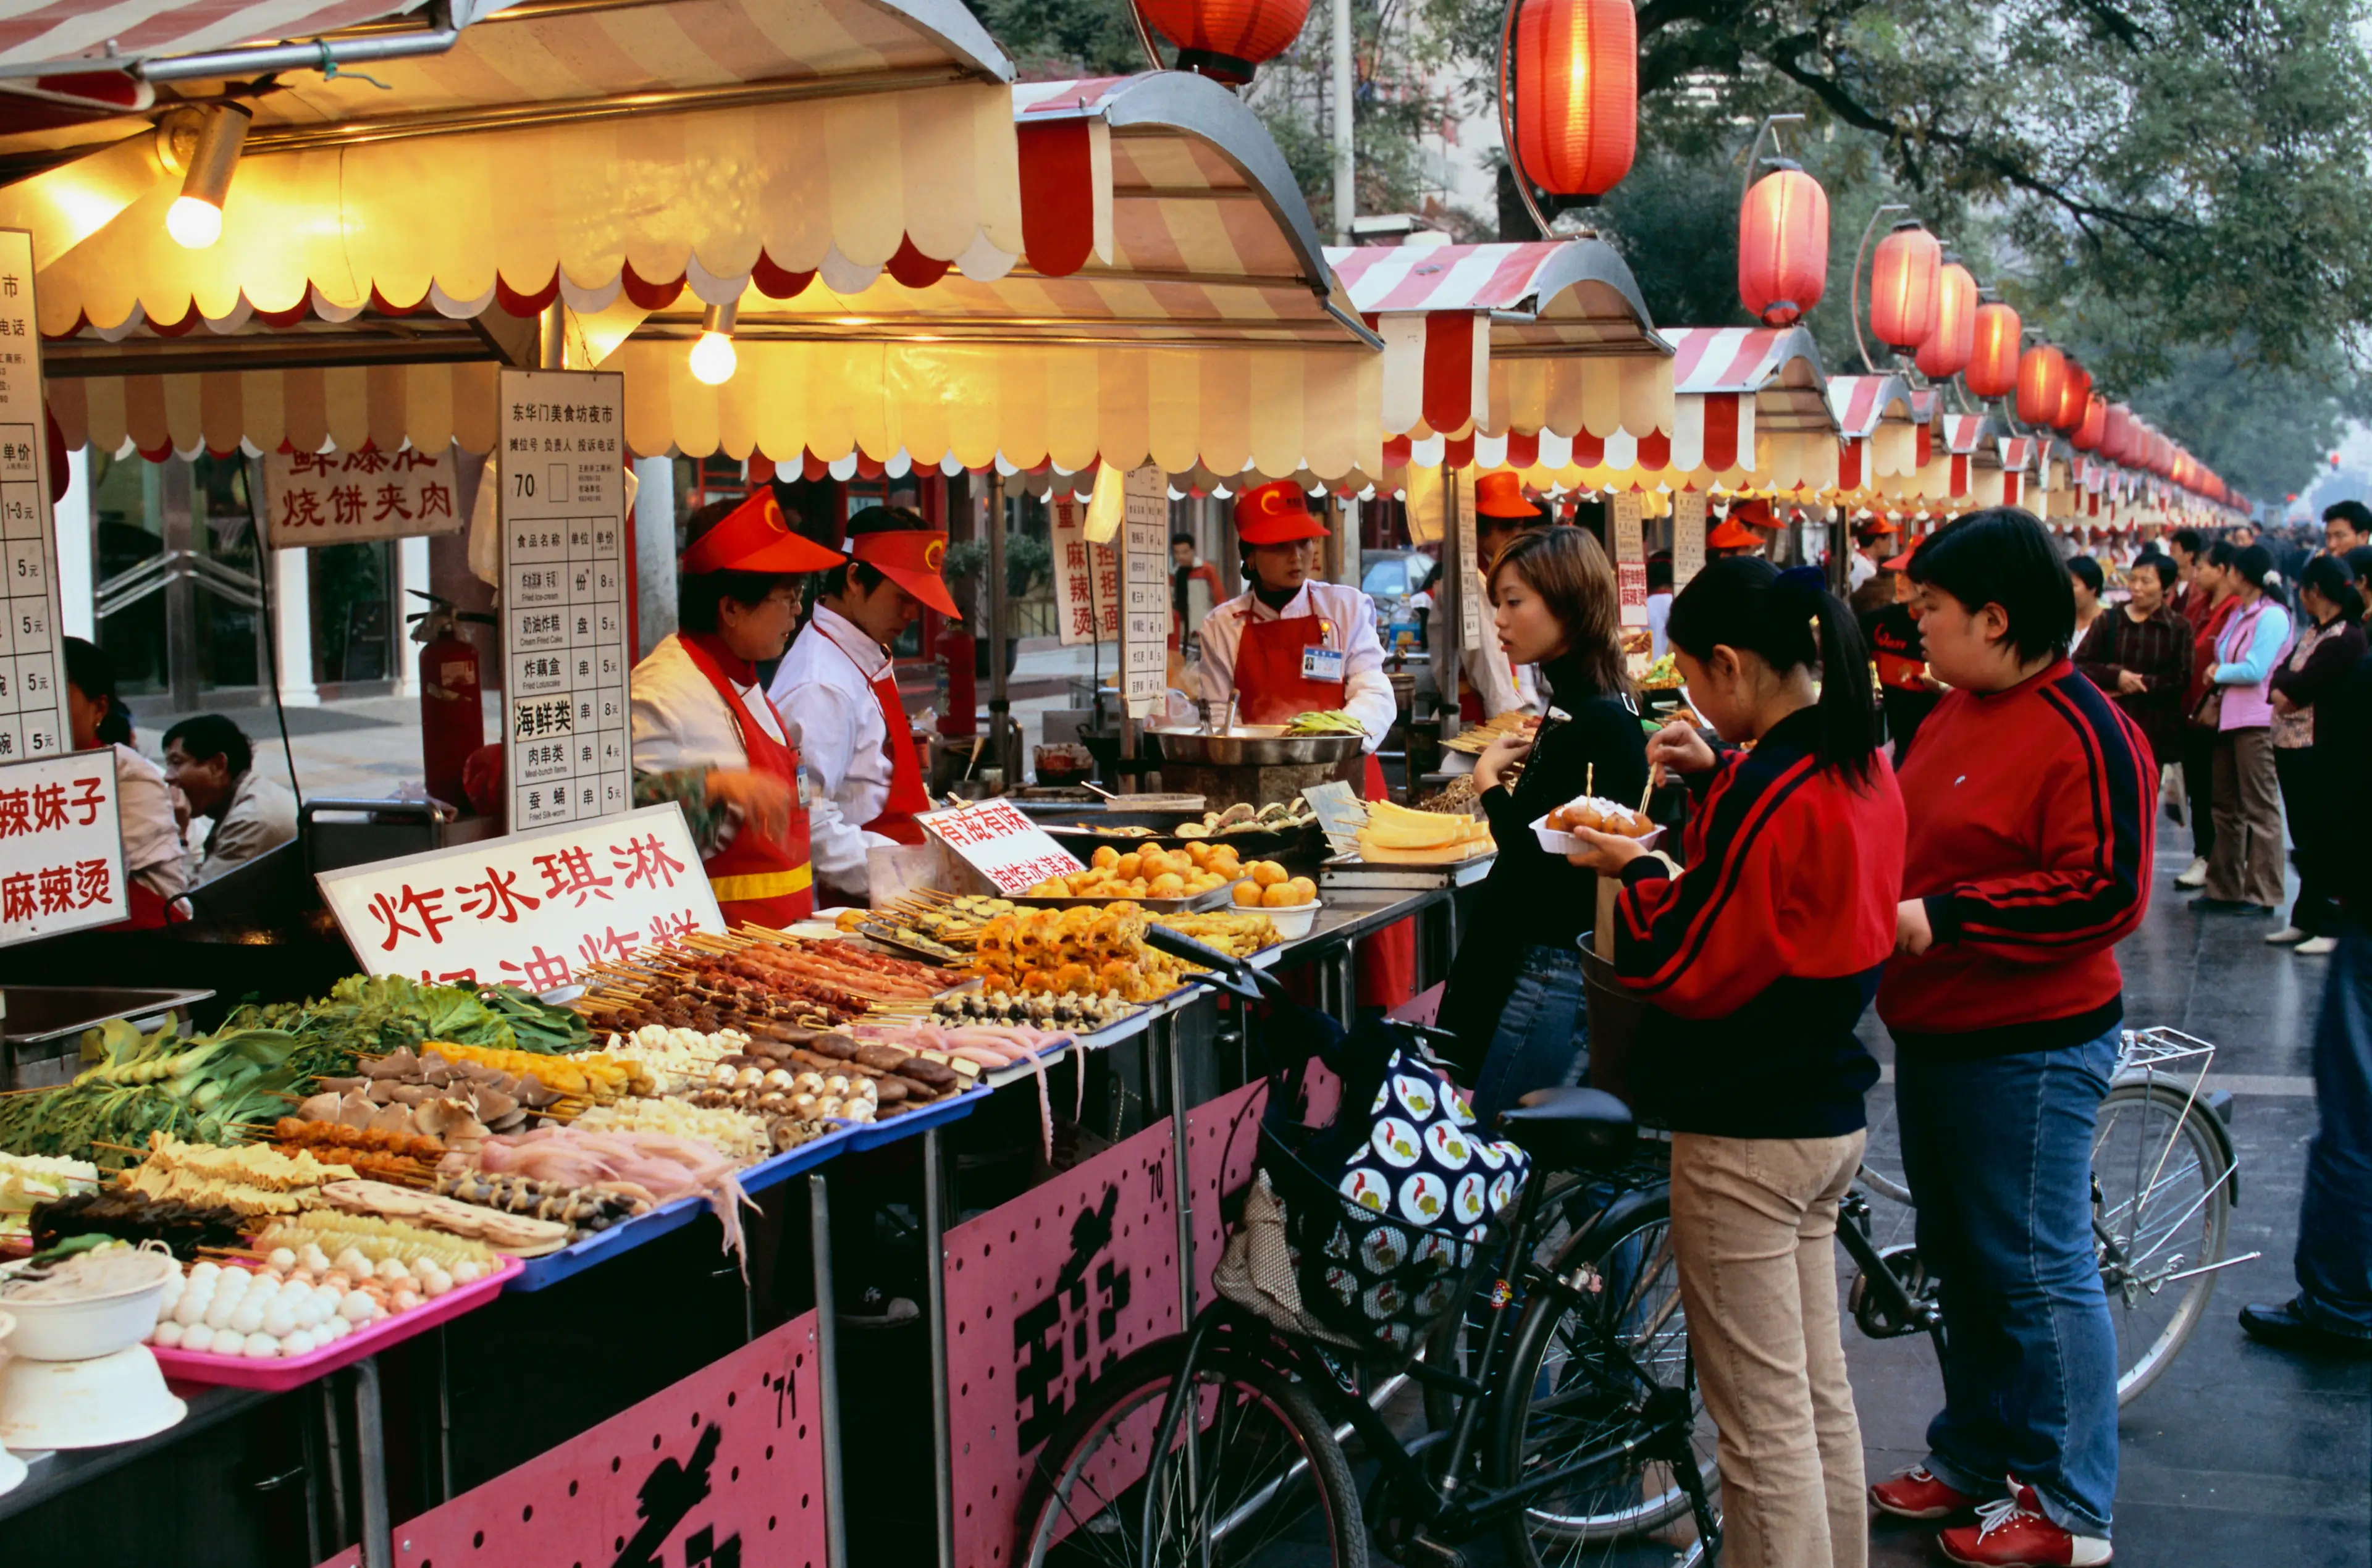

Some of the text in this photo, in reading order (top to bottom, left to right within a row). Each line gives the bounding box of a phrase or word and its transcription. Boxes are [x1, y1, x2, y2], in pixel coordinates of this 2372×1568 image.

[2, 274, 19, 298] 市
[513, 403, 613, 424] 东华门美食坊夜市
[3, 443, 30, 462] 单价
[510, 438, 615, 452] 摊位号 负责人 投诉电话
[515, 474, 535, 498] 70
[6, 501, 34, 519] 1-3元
[282, 480, 452, 527] 烧饼夹肉
[518, 530, 614, 548] 食品名称 单位 单价
[18, 558, 39, 577] 5元
[600, 574, 614, 588] 8元
[1066, 541, 1093, 636] 麻辣烫
[23, 616, 43, 634] 5元
[523, 614, 616, 634] 奶油炸糕 盘 5元
[524, 657, 617, 678] 炸藕盒 串 5元
[28, 673, 48, 691] 5元
[516, 700, 618, 737] 海鲜类 串 8元
[33, 733, 54, 750] 5元
[528, 744, 620, 766] 肉串类 串 4元
[583, 788, 594, 805] 串
[608, 787, 621, 800] 5元
[0, 778, 106, 839] 辣妹子
[928, 802, 1032, 847] 有滋有味
[2, 858, 113, 924] 麻辣烫
[368, 833, 685, 952] 炸冰琪淋
[1148, 1160, 1163, 1204] 70
[773, 1369, 796, 1429] 71
